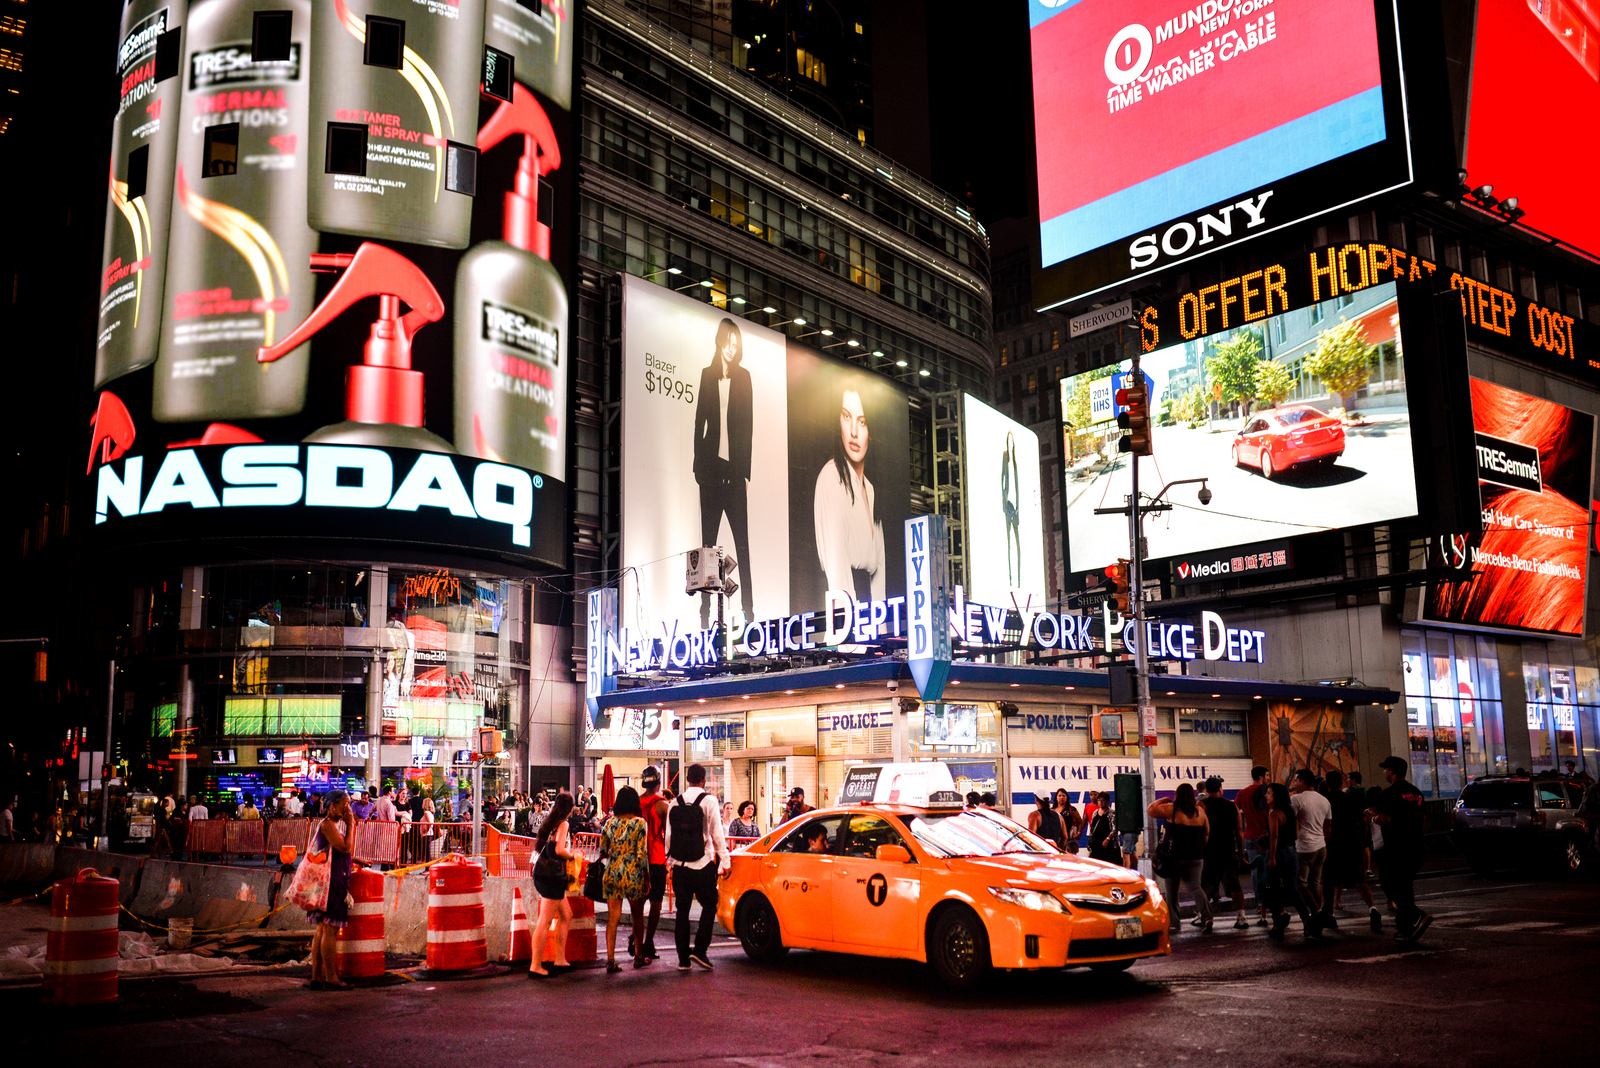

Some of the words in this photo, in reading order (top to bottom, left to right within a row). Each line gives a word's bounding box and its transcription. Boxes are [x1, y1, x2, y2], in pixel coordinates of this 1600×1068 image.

[1200, 12, 1231, 37] NEW
[1107, 85, 1142, 114] TIME
[1147, 52, 1214, 96] WARNER
[1219, 22, 1277, 62] CABLE
[361, 110, 401, 127] TAMER
[384, 127, 420, 143] SPRAY
[1128, 190, 1274, 270] SONY
[1178, 263, 1289, 340] OFFER
[1450, 272, 1516, 337] STEEP
[1527, 302, 1574, 359] COST
[1072, 305, 1130, 333] SHERWOOD
[645, 352, 676, 374] Blazer
[645, 369, 694, 403] $19.95
[1093, 388, 1109, 400] 2014
[1093, 398, 1110, 412] IIHS
[1476, 445, 1538, 481] TRESemmé
[95, 445, 533, 547] NASDAQ
[1496, 510, 1513, 527] Hair
[1514, 513, 1532, 530] Care
[1534, 518, 1565, 538] Sponsor
[1566, 525, 1574, 540] of
[1471, 546, 1533, 572] Mercedes-Benz
[910, 521, 928, 656] NYPD
[606, 627, 653, 676] NEW
[660, 618, 718, 669] YORK
[726, 610, 816, 660] POLICE
[825, 589, 906, 646] DEPT
[949, 585, 1008, 643] NEW
[1010, 591, 1093, 651] YORK
[1202, 610, 1265, 663] DEPT
[589, 593, 599, 694] NYPD
[696, 724, 735, 741] POLICE
[831, 712, 880, 731] POLICE
[1026, 714, 1074, 730] POLICE
[1193, 719, 1233, 734] POLICE
[1019, 765, 1093, 780] WELCOME
[1095, 766, 1112, 780] TO
